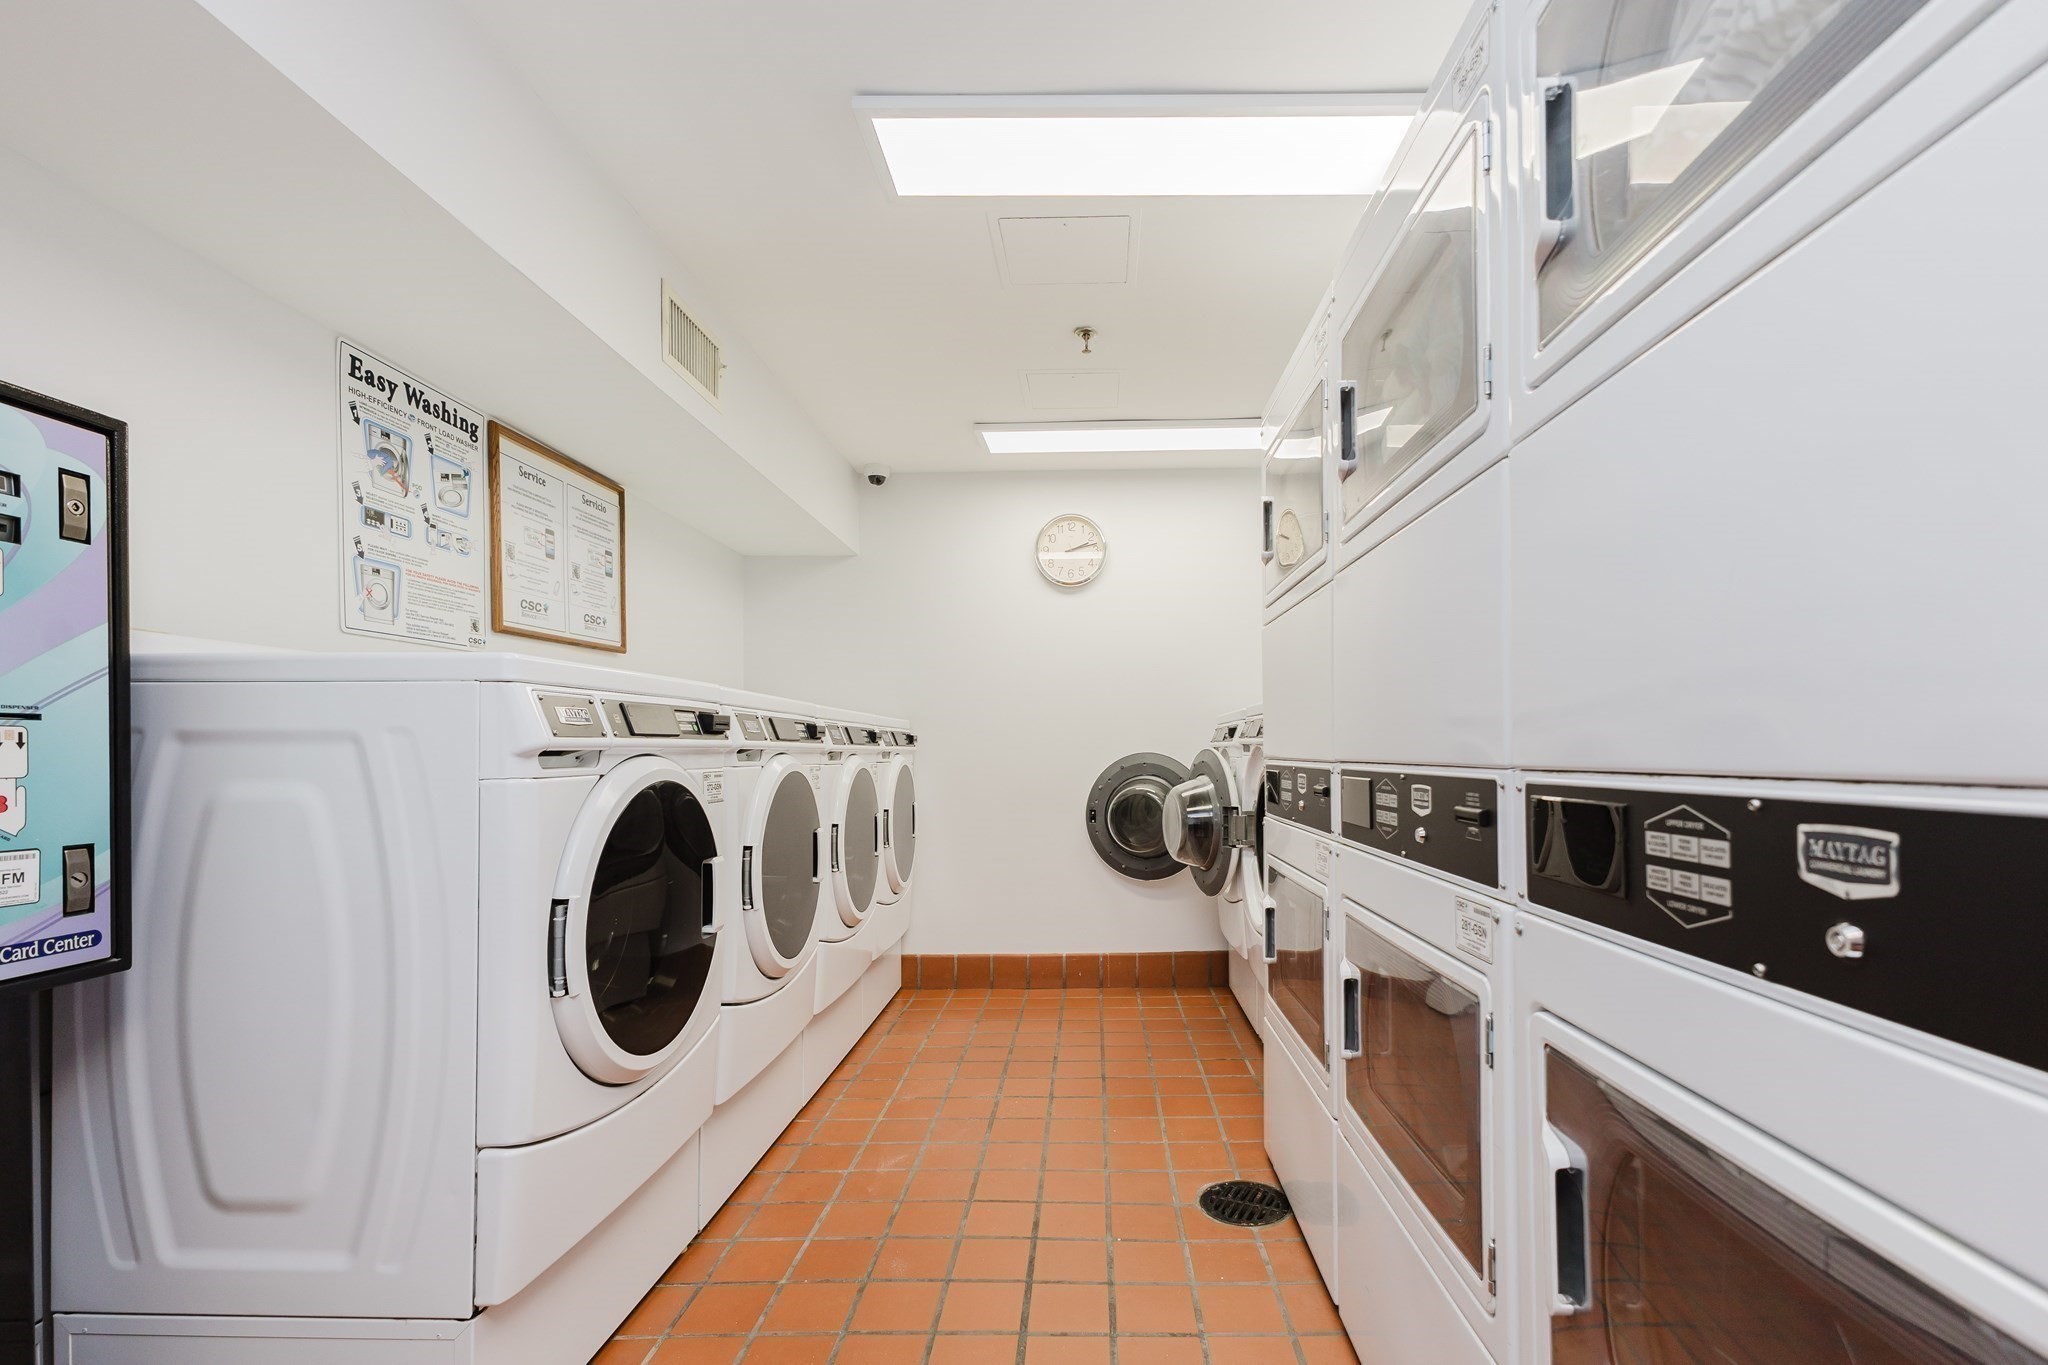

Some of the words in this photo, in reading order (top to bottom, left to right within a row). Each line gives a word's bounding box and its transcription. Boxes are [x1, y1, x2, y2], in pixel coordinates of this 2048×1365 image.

[348, 353, 399, 403] Easy
[403, 381, 479, 443] Washing
[348, 386, 408, 418] HIGH-EFFICIENCY
[417, 418, 438, 433] FRONT
[439, 429, 455, 441] LOAD
[456, 436, 479, 452] WASHER
[518, 465, 547, 487] Service
[581, 494, 607, 513] Servicio
[1057, 525, 1064, 534] 11
[1067, 522, 1076, 531] 12
[1047, 533, 1057, 543] 10
[1088, 532, 1095, 541] 2
[520, 599, 542, 613] CSC
[583, 613, 602, 626] CSC
[468, 637, 482, 645] CSC
[1808, 838, 1887, 867] MAYTAG
[0, 940, 39, 963] Card
[43, 933, 95, 955] Center
